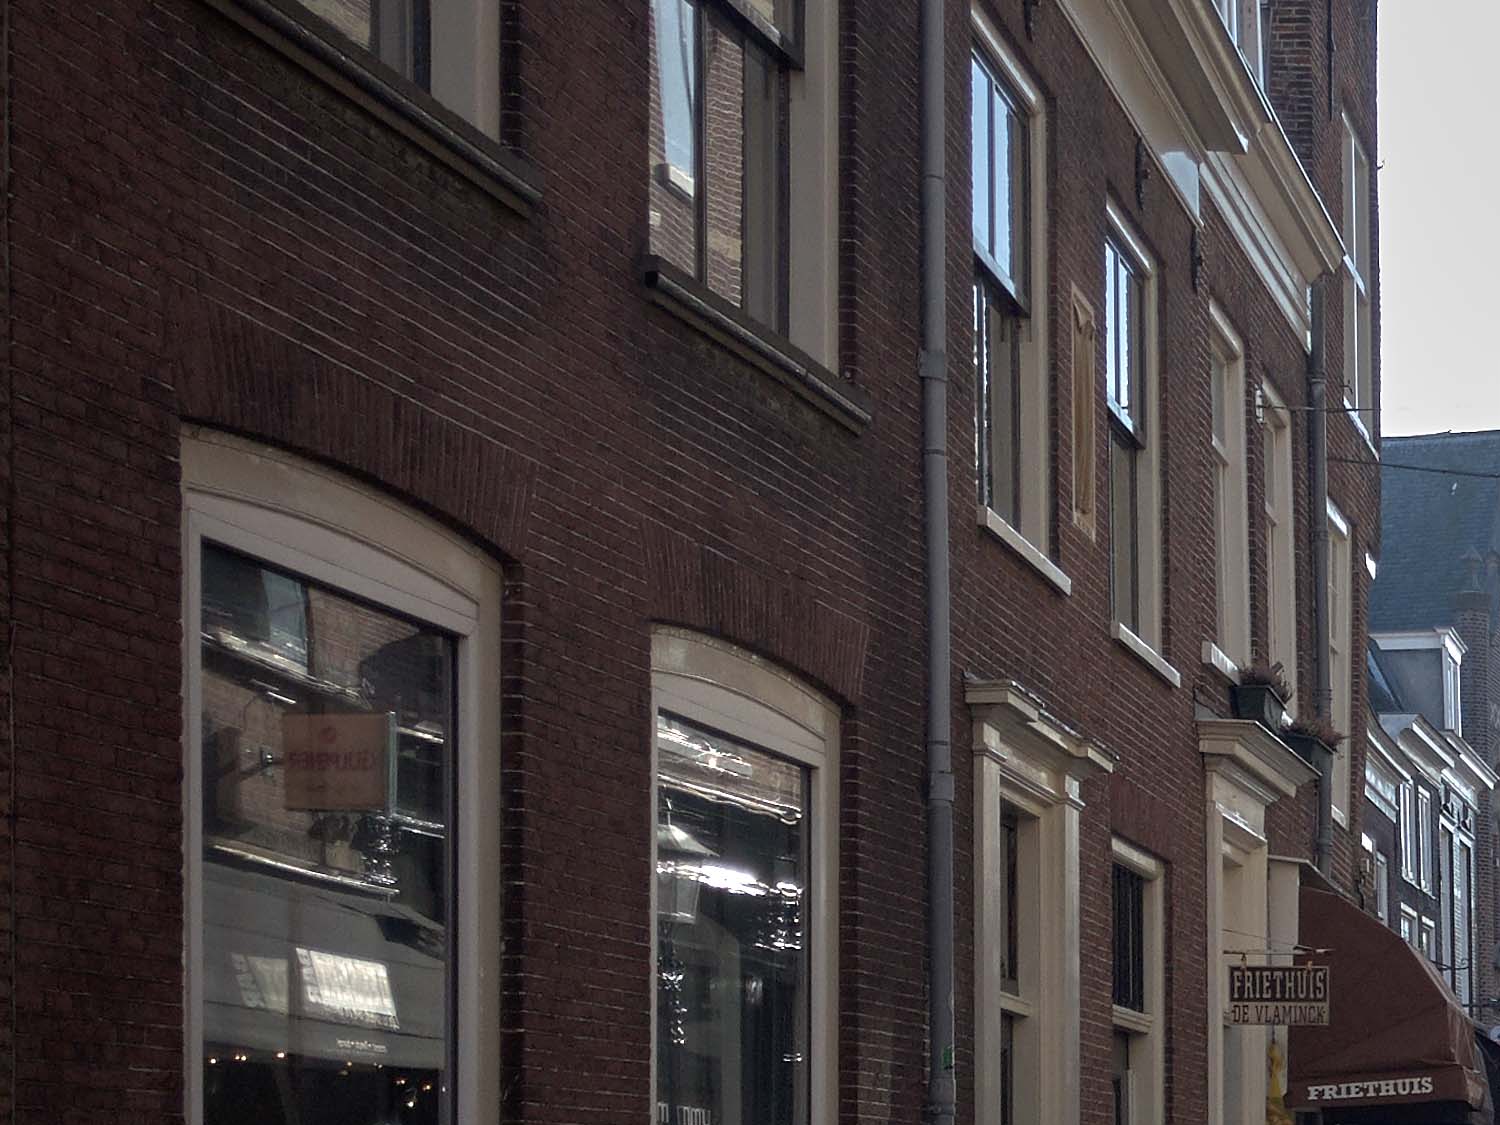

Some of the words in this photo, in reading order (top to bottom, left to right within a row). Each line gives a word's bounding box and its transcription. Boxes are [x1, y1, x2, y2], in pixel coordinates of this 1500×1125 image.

[1233, 969, 1326, 1000] FRIETHUIS
[1232, 1004, 1249, 1024] DE
[1255, 1003, 1326, 1025] VLAMINCK
[1307, 1076, 1434, 1101] FRIETHUIS
